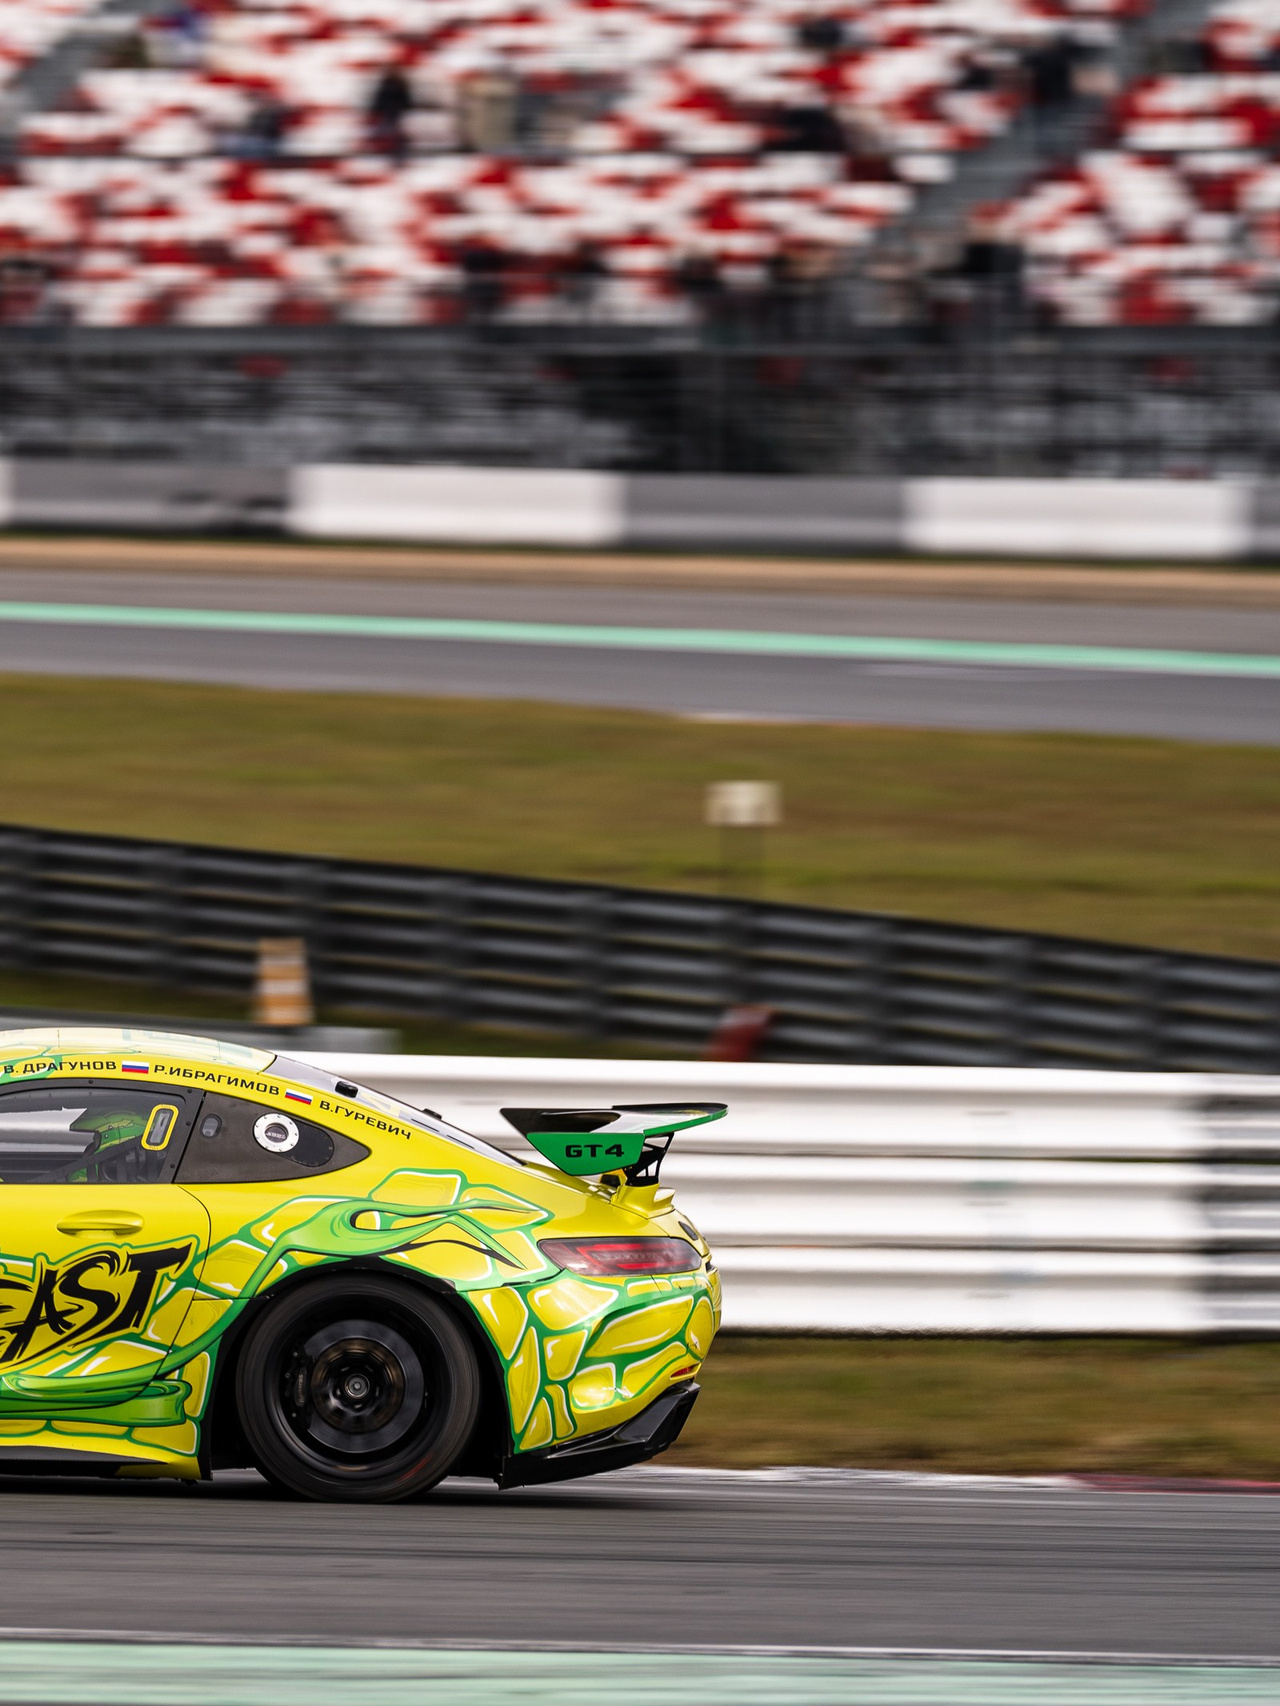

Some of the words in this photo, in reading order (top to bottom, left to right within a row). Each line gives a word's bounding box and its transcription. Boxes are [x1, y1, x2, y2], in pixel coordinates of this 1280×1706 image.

[22, 1060, 117, 1075] ДРАГУНОВ
[153, 1064, 280, 1095] Р.ИБРАГИМОВ
[319, 1100, 412, 1140] В.ГУРЕВИЧ
[565, 1143, 625, 1158] GT4
